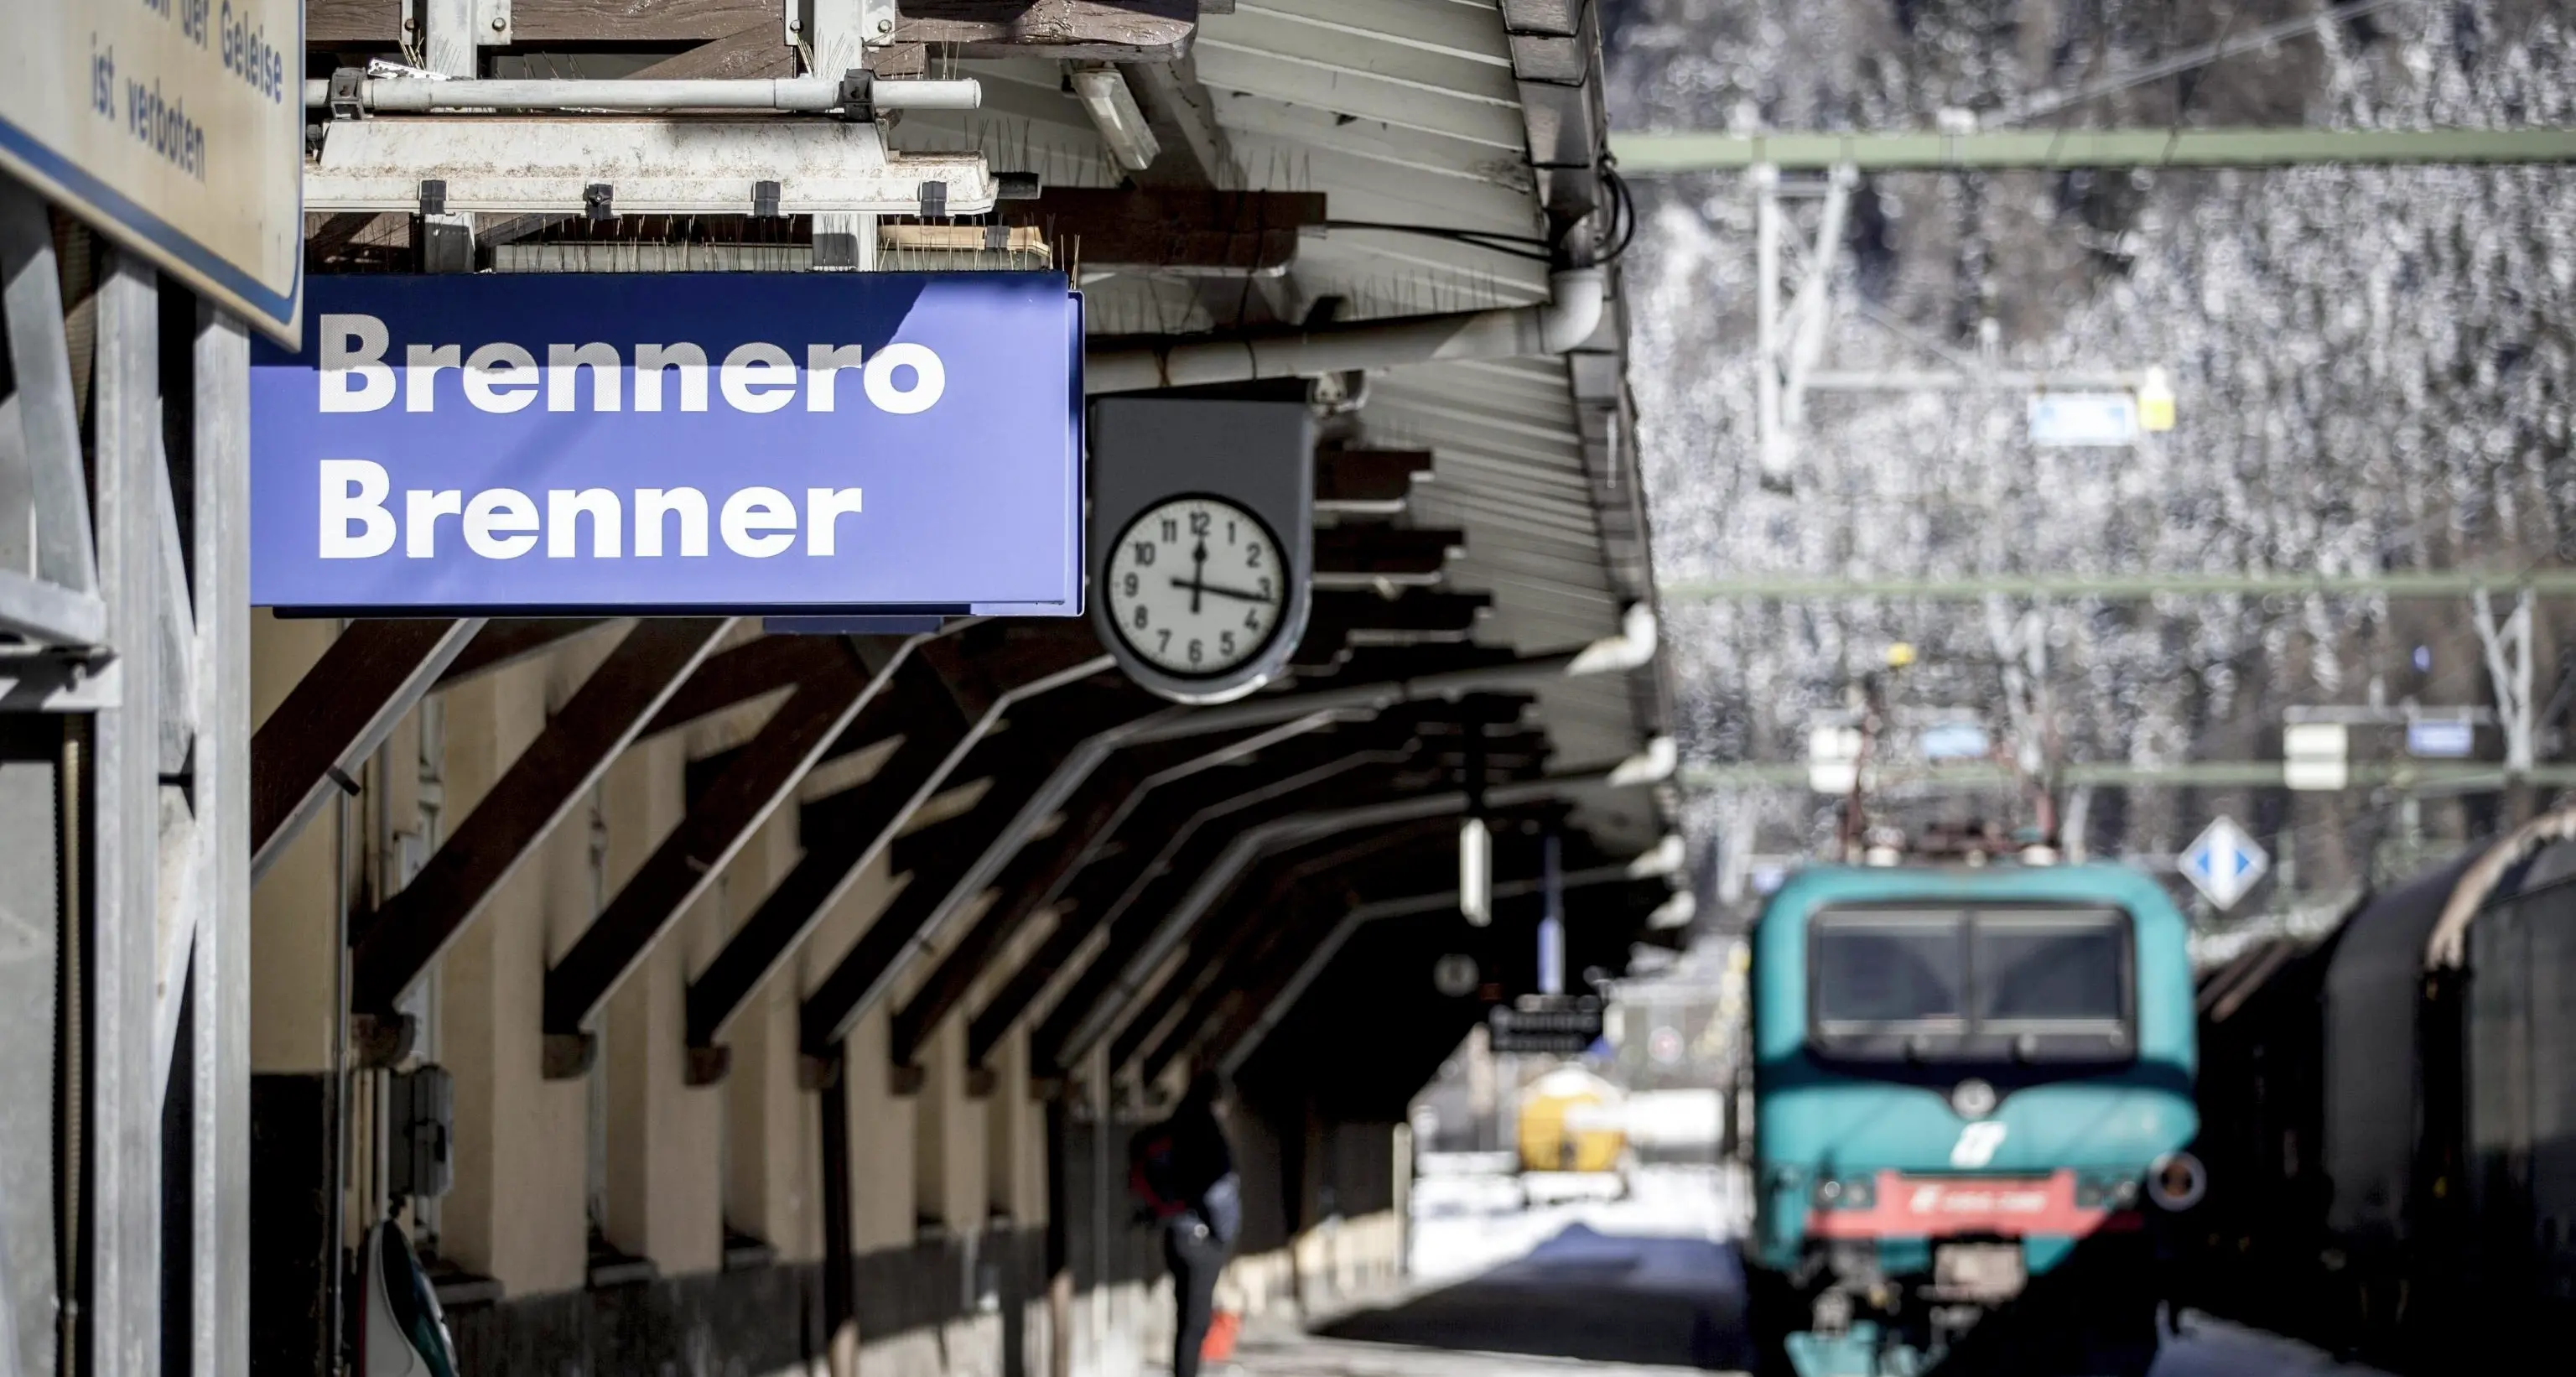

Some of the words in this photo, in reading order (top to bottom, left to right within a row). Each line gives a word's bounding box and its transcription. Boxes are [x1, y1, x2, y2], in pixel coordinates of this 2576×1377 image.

[221, 0, 283, 105] Geleise
[91, 31, 115, 121] ist
[127, 77, 207, 184] verboten
[319, 314, 946, 414] Brennero
[319, 459, 862, 559] Brenner
[1162, 519, 1177, 543] 11
[1189, 511, 1211, 537] 12
[1227, 520, 1236, 544] 1
[1135, 541, 1156, 567] 10
[1245, 543, 1262, 568] 2
[1124, 572, 1139, 598] 9
[1259, 576, 1272, 602] 3
[1134, 604, 1149, 630] 8
[1244, 606, 1260, 631] 4
[1156, 629, 1171, 654] 7
[1187, 638, 1202, 663] 6
[1219, 631, 1235, 657] 5
